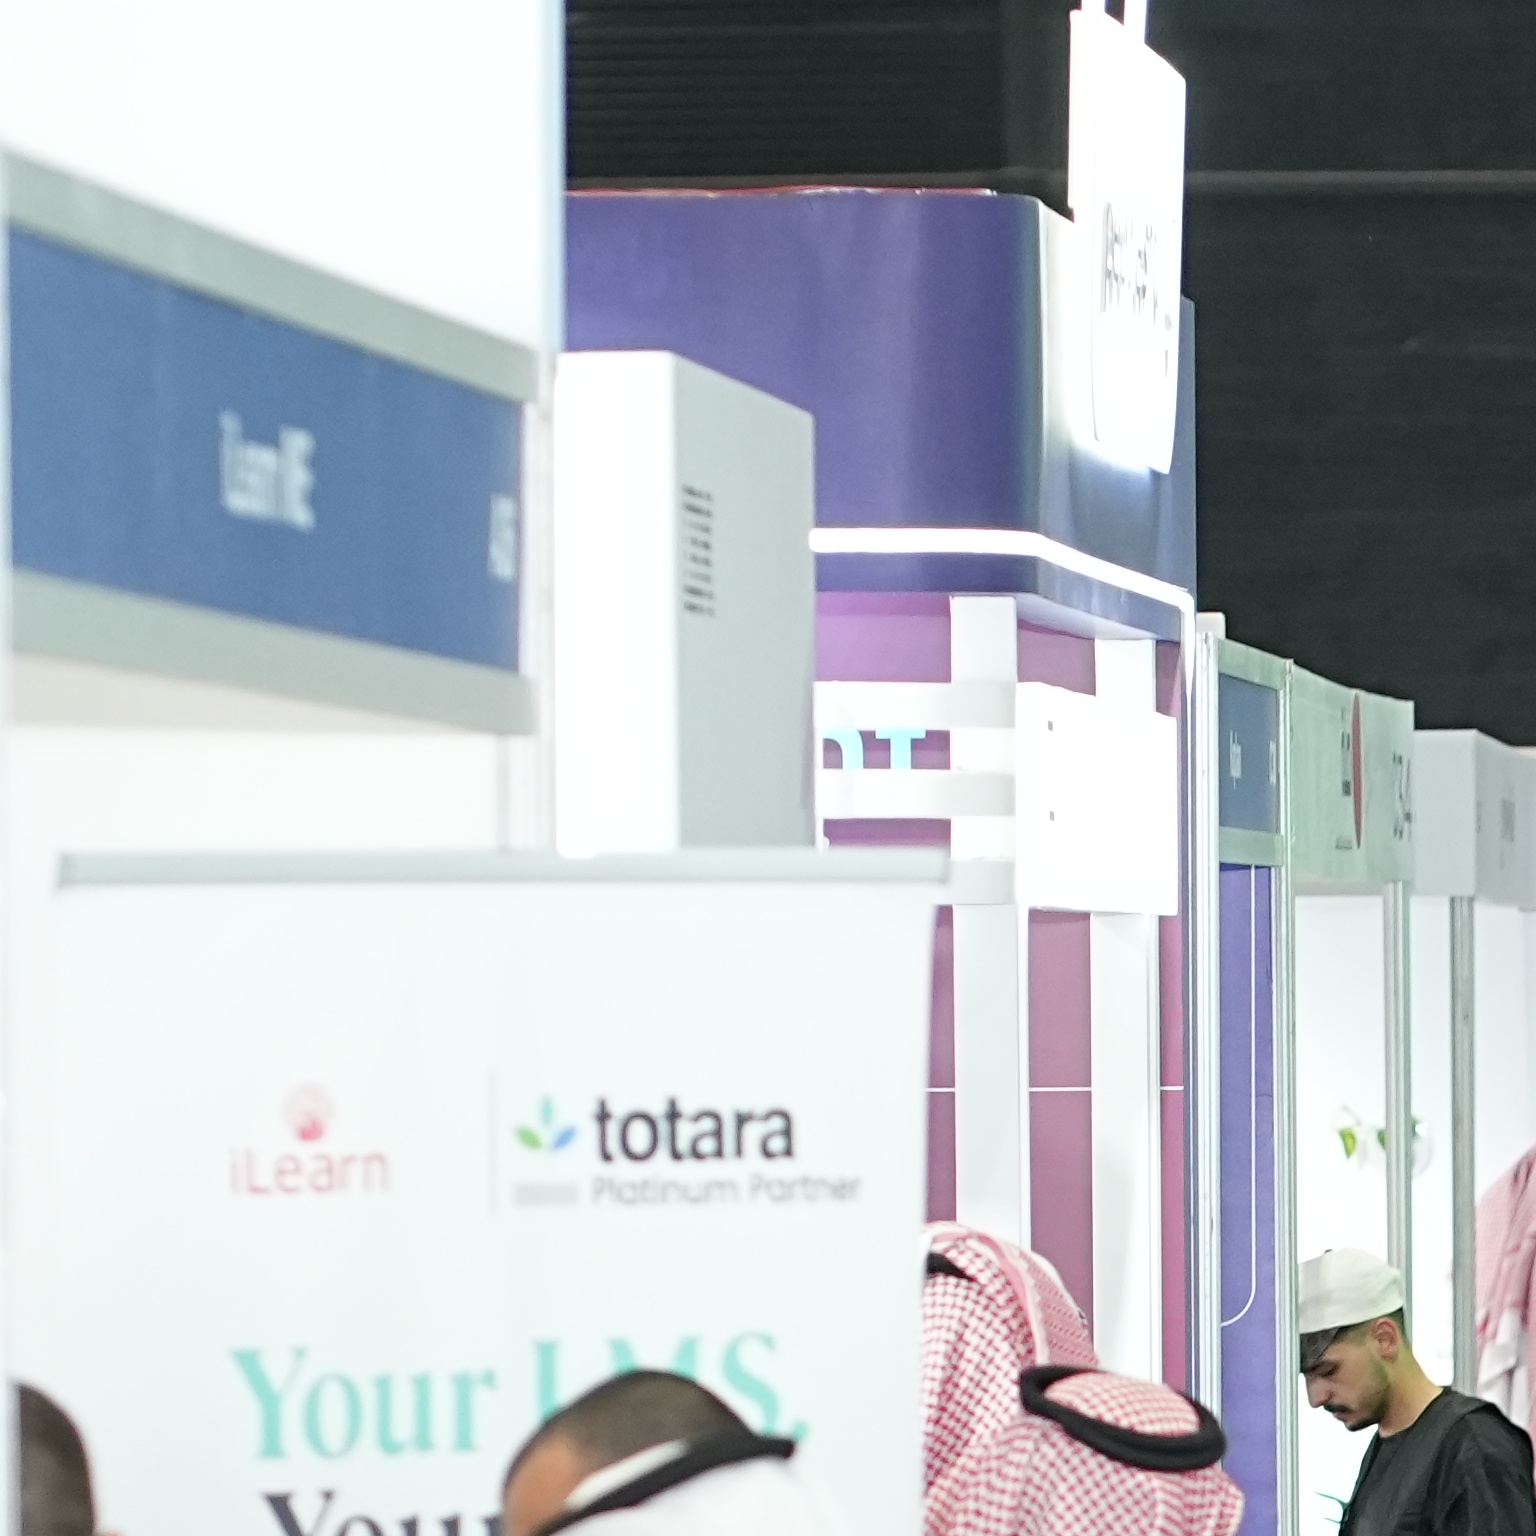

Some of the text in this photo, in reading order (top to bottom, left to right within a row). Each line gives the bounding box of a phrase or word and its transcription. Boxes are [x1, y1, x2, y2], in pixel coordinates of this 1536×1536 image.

[592, 1095, 796, 1163] totara
[230, 1149, 389, 1196] iLearn
[592, 1174, 748, 1207] Platinum
[750, 1172, 862, 1204] Partner
[229, 1345, 498, 1462] Your
